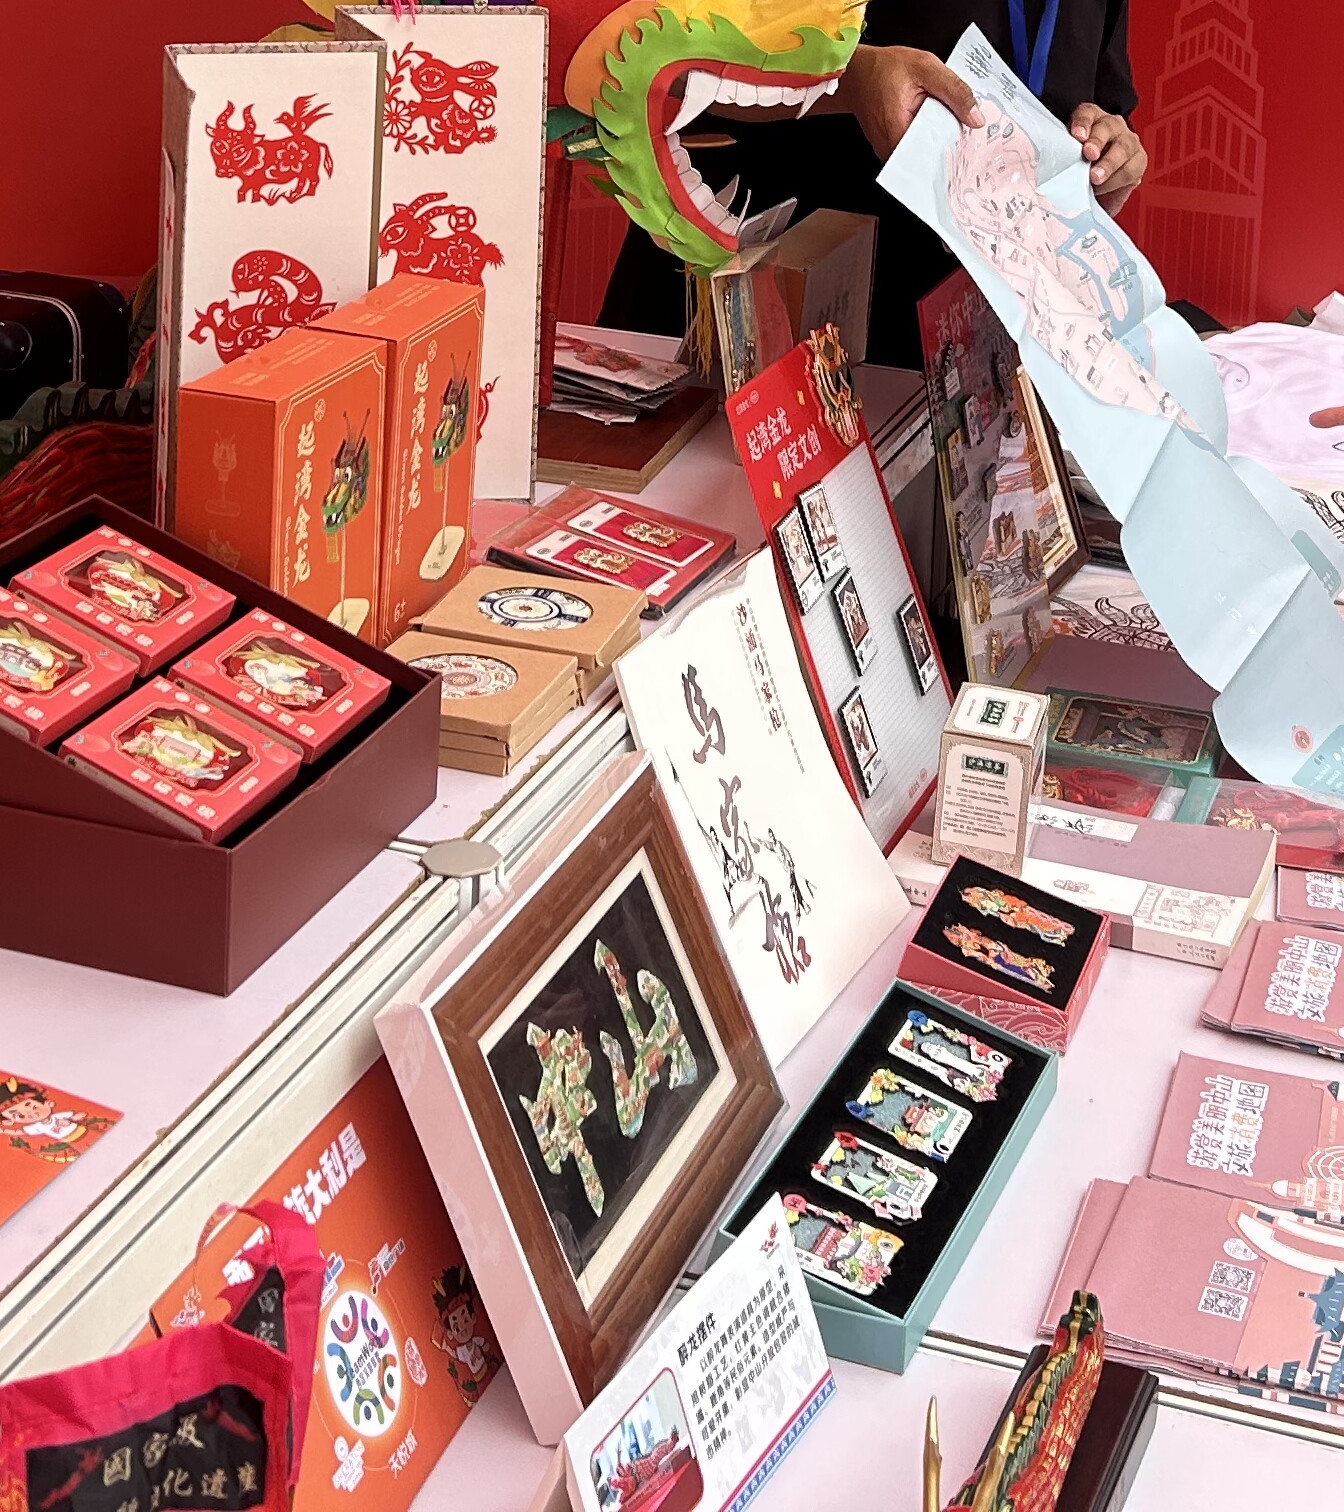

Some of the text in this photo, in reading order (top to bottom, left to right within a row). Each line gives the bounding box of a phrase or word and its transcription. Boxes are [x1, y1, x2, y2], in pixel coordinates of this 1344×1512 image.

[408, 360, 429, 515] 起湾金龙
[746, 406, 792, 463] 起湾金龙
[777, 424, 822, 482] 限定文创
[293, 420, 316, 588] 起湾金龙
[677, 1311, 717, 1367] 醉龙摆件
